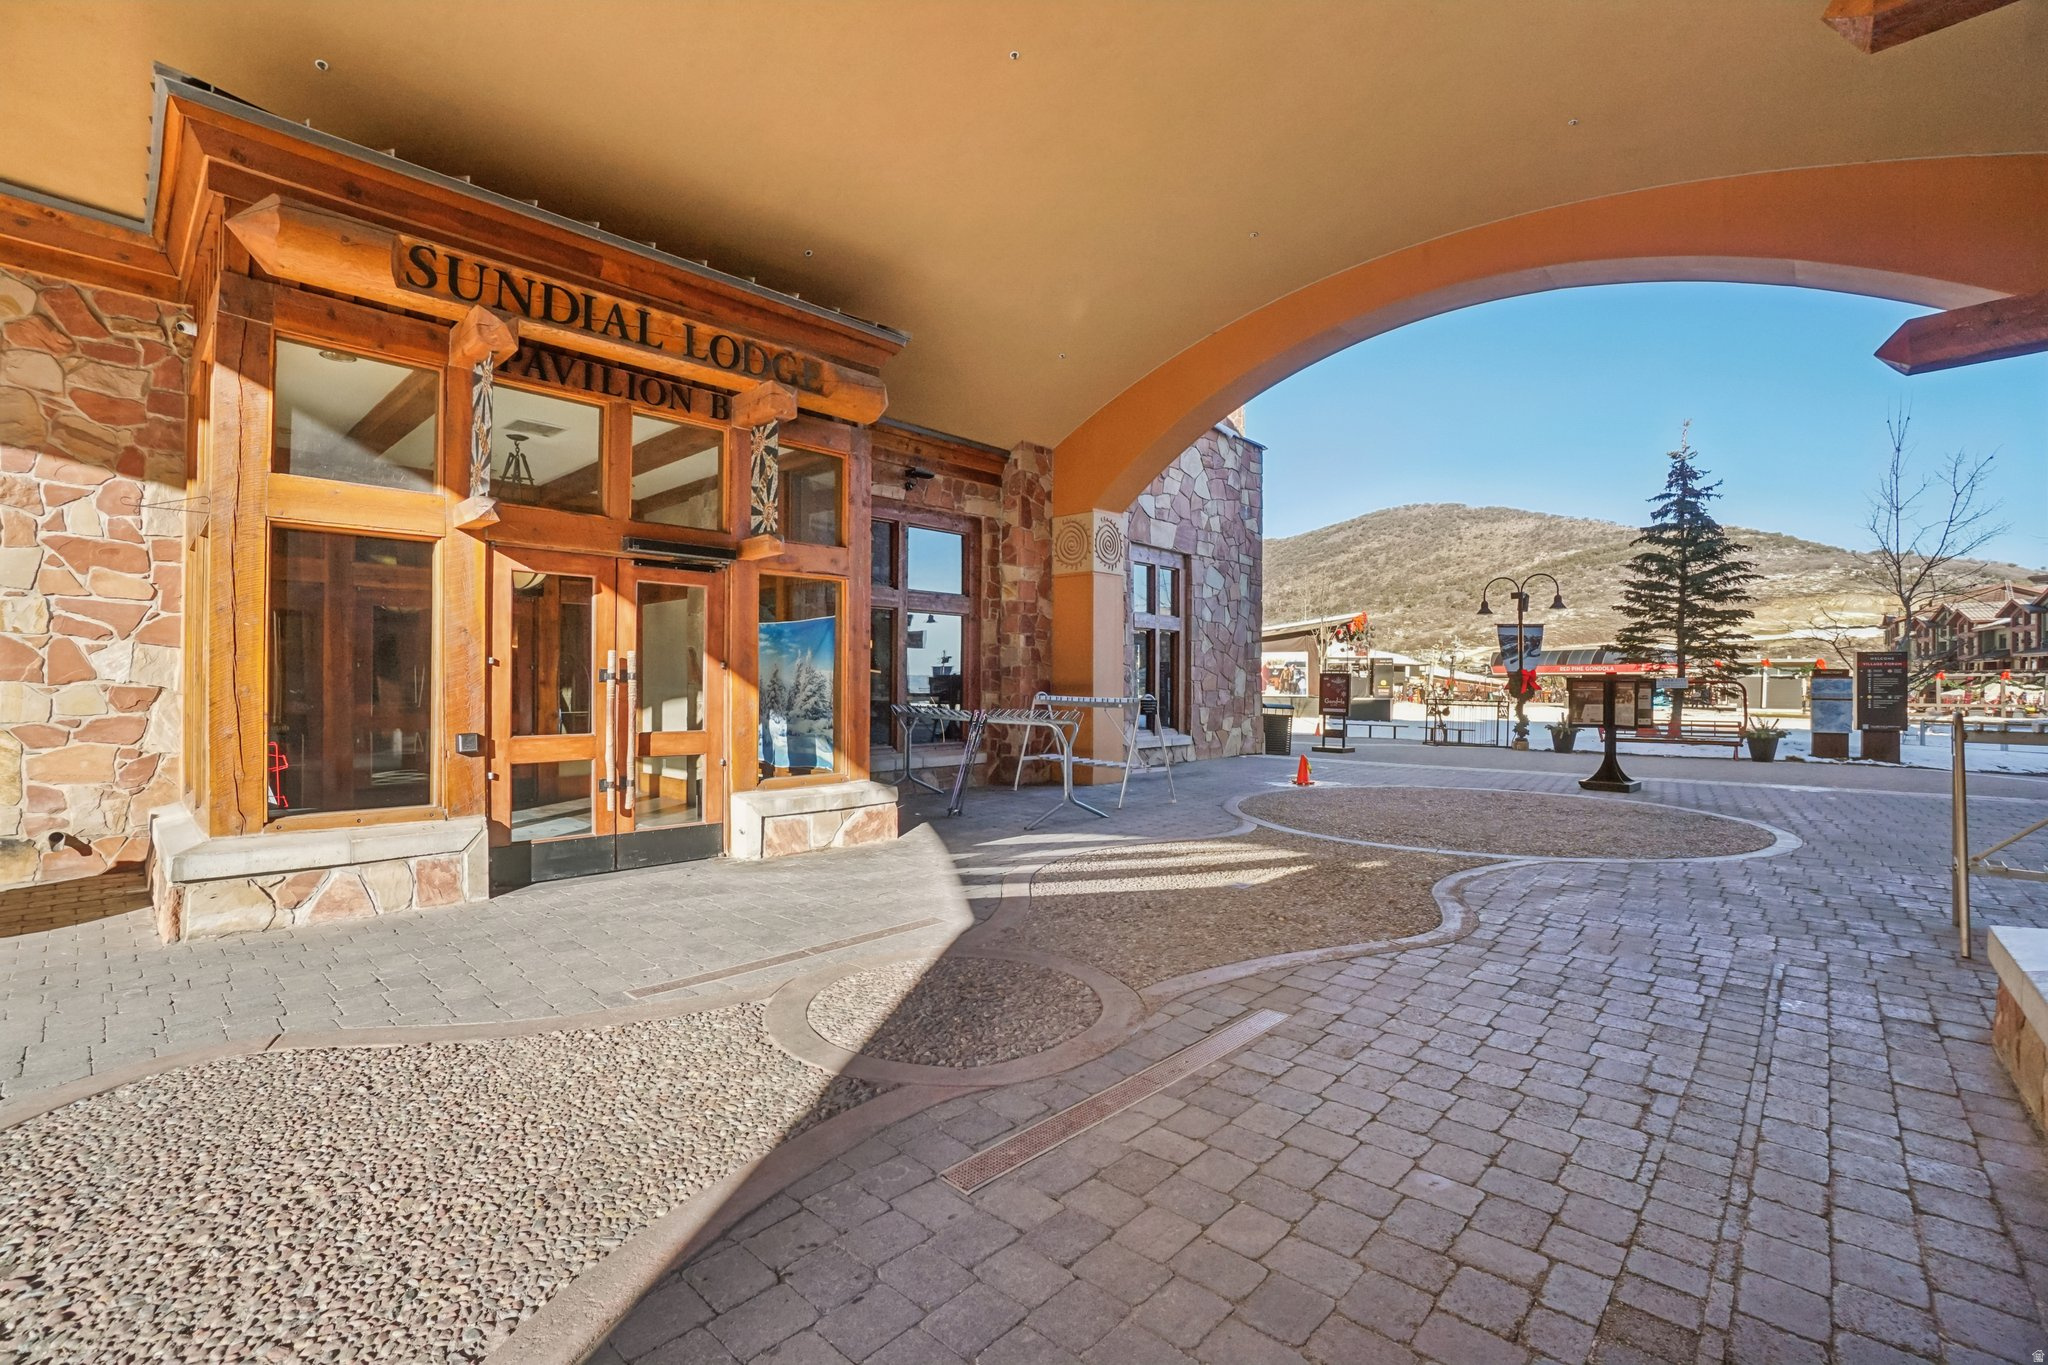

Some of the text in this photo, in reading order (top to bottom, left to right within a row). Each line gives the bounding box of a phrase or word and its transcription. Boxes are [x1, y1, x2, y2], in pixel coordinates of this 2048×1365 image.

[405, 244, 826, 396] SUNDIAL LODGE
[710, 393, 731, 420] B
